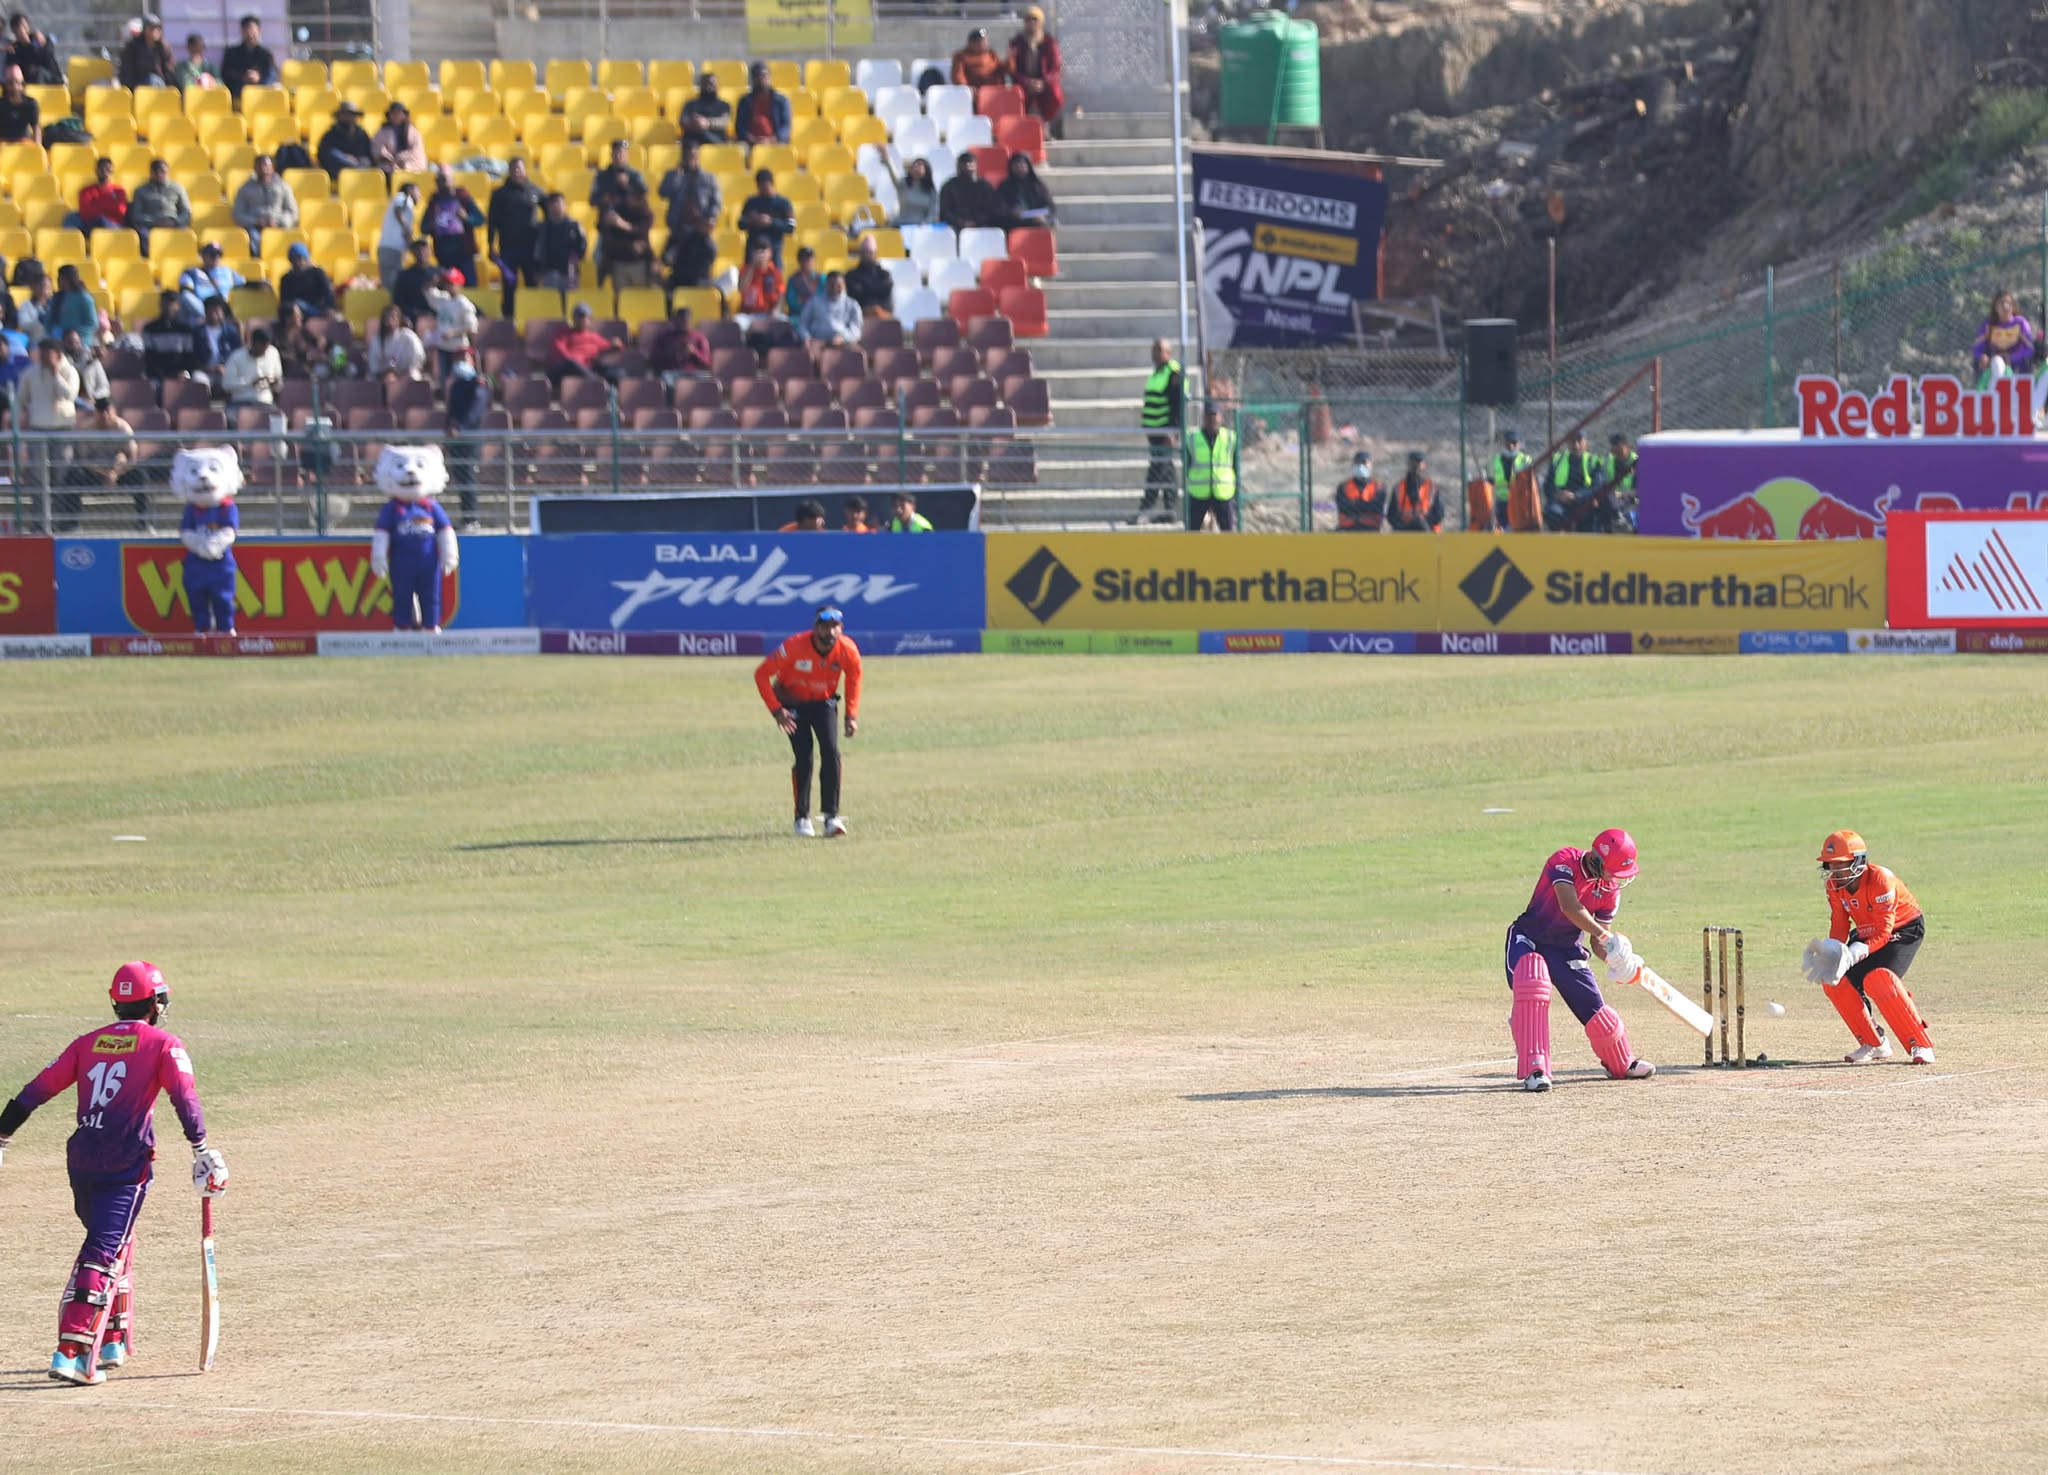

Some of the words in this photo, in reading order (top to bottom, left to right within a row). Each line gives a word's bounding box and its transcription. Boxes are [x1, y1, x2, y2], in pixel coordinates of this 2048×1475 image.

[1208, 183, 1351, 222] RESTROOMS
[1241, 252, 1351, 306] NPL
[1796, 375, 1911, 437] Red
[1919, 375, 2036, 437] Bull
[655, 544, 758, 562] BAJAJ
[295, 557, 394, 617] WA
[609, 546, 919, 629] pulsar
[568, 631, 626, 654] Ncell
[679, 632, 737, 655] Ncell
[1328, 633, 1394, 653] vivo
[1441, 632, 1498, 654] Ncell
[1550, 632, 1606, 654] Ncell
[86, 1060, 128, 1110] 16
